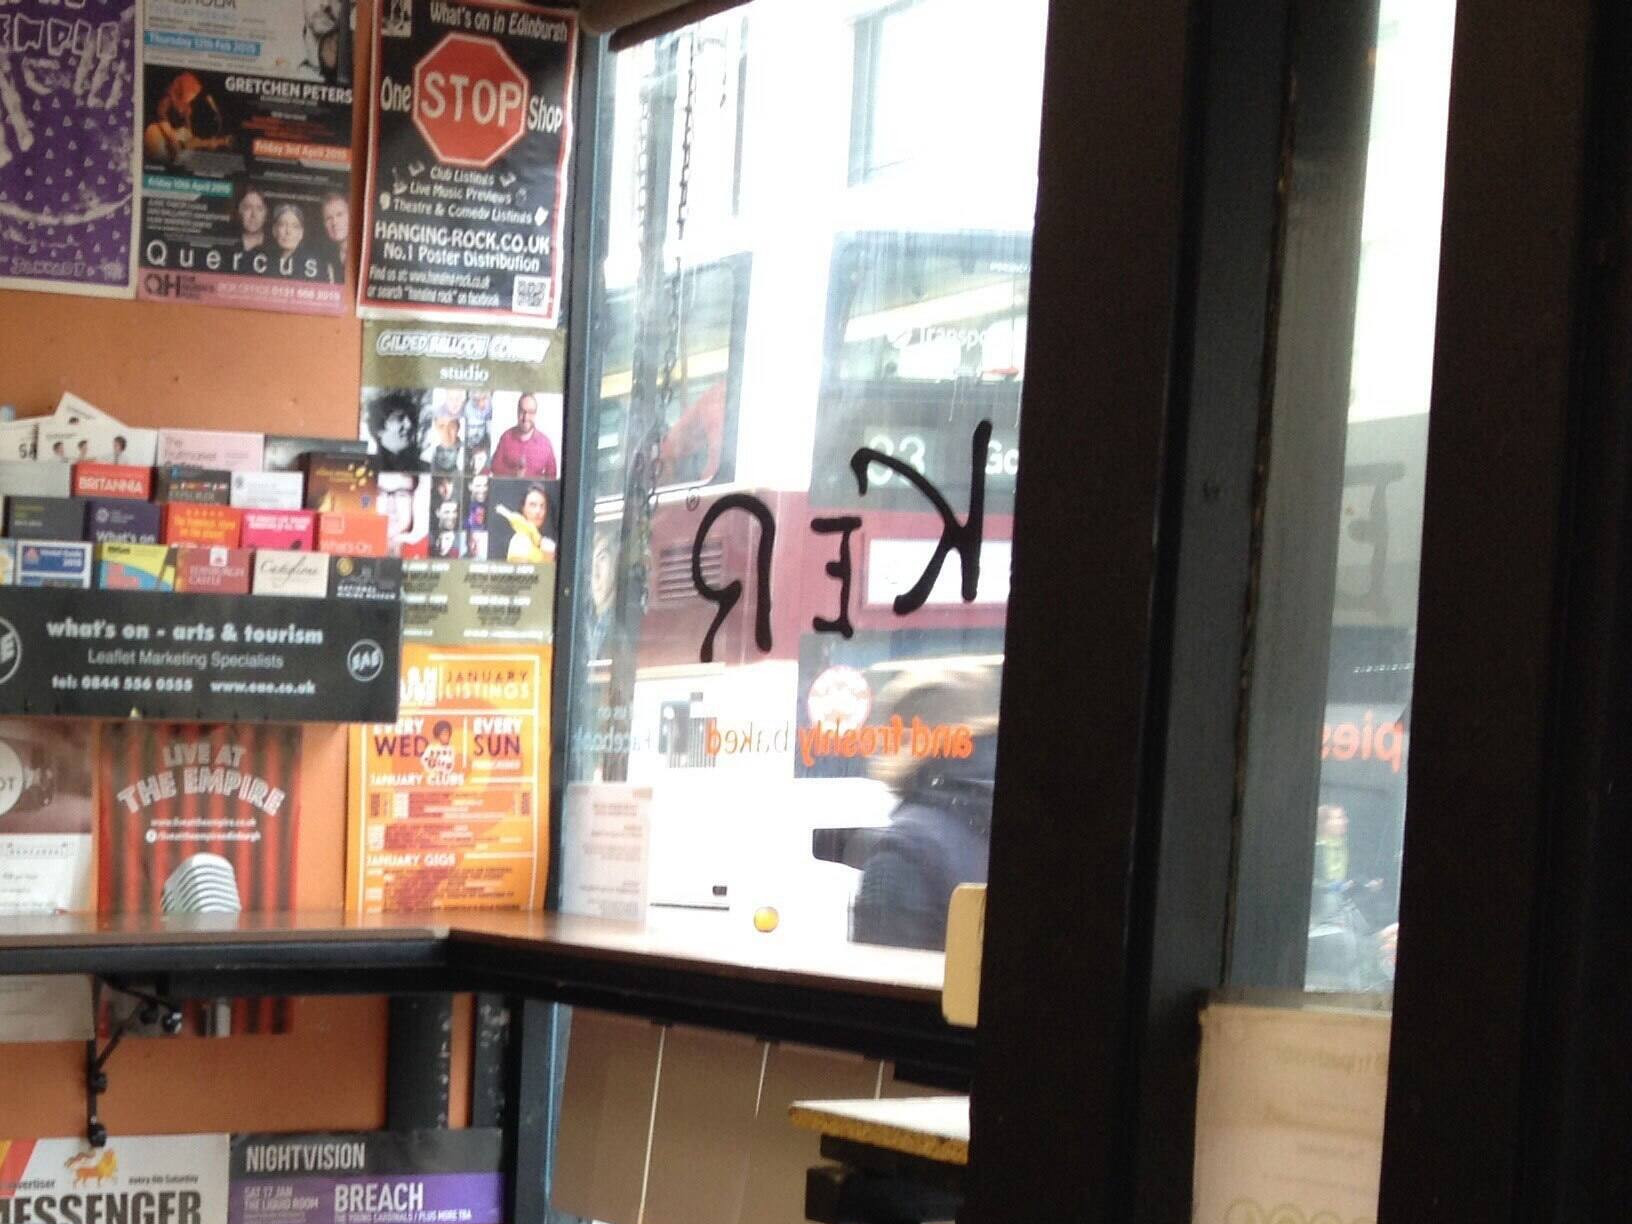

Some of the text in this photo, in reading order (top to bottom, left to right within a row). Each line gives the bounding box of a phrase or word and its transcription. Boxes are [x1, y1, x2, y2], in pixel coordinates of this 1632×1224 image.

[430, 4, 568, 42] What's on in Edinburgh
[225, 76, 353, 104] GRETCHEN PETERS
[380, 71, 563, 134] One STOP Shop
[431, 167, 494, 186] Club Listings
[410, 181, 511, 204] Live Music Previews
[394, 199, 432, 215] Theatre
[448, 204, 490, 221] Comedy
[492, 207, 532, 225] Listings
[147, 239, 318, 278] Quercus
[419, 246, 460, 267] Poster
[464, 250, 539, 274] Distribution
[440, 364, 489, 383] studio
[78, 476, 144, 494] BRITANNIA
[46, 616, 323, 645] what's on arts & tourism
[88, 648, 284, 671] Leaflet Marketing Specialists
[52, 674, 77, 690] tel:
[81, 674, 119, 691] 0844
[447, 670, 530, 684] JANUARY
[445, 682, 530, 700] LISTINGS
[473, 718, 524, 735] EVERY
[163, 742, 248, 769] LIVE AT
[374, 735, 430, 758] WED
[473, 734, 521, 757] SUN
[117, 765, 286, 817] THE EMPIRE
[246, 1142, 366, 1173] NIGHTVISION
[334, 1181, 425, 1214] BREACH
